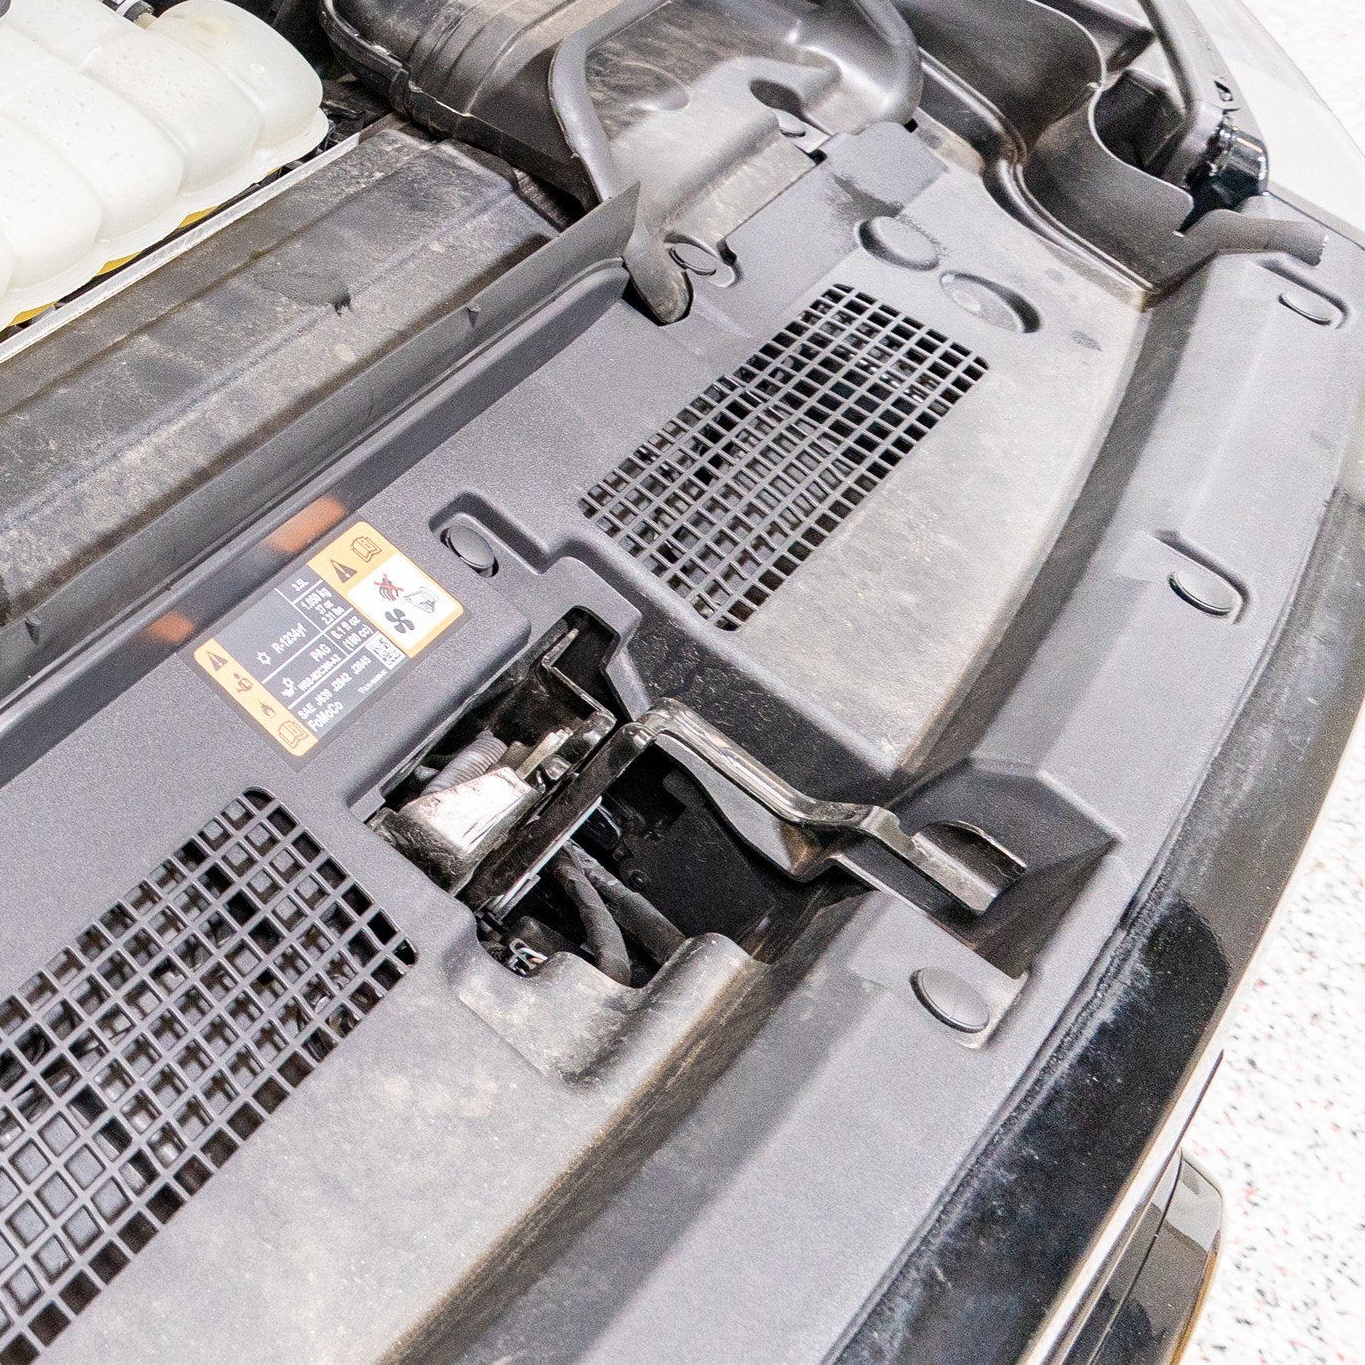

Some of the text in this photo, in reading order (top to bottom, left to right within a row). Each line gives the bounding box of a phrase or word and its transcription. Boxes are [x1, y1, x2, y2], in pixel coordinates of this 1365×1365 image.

[271, 623, 308, 655] R-1234yf
[315, 585, 332, 600] kg
[309, 642, 332, 662] PAG
[296, 702, 317, 720] SAE
[307, 699, 344, 731] FoMoCo
